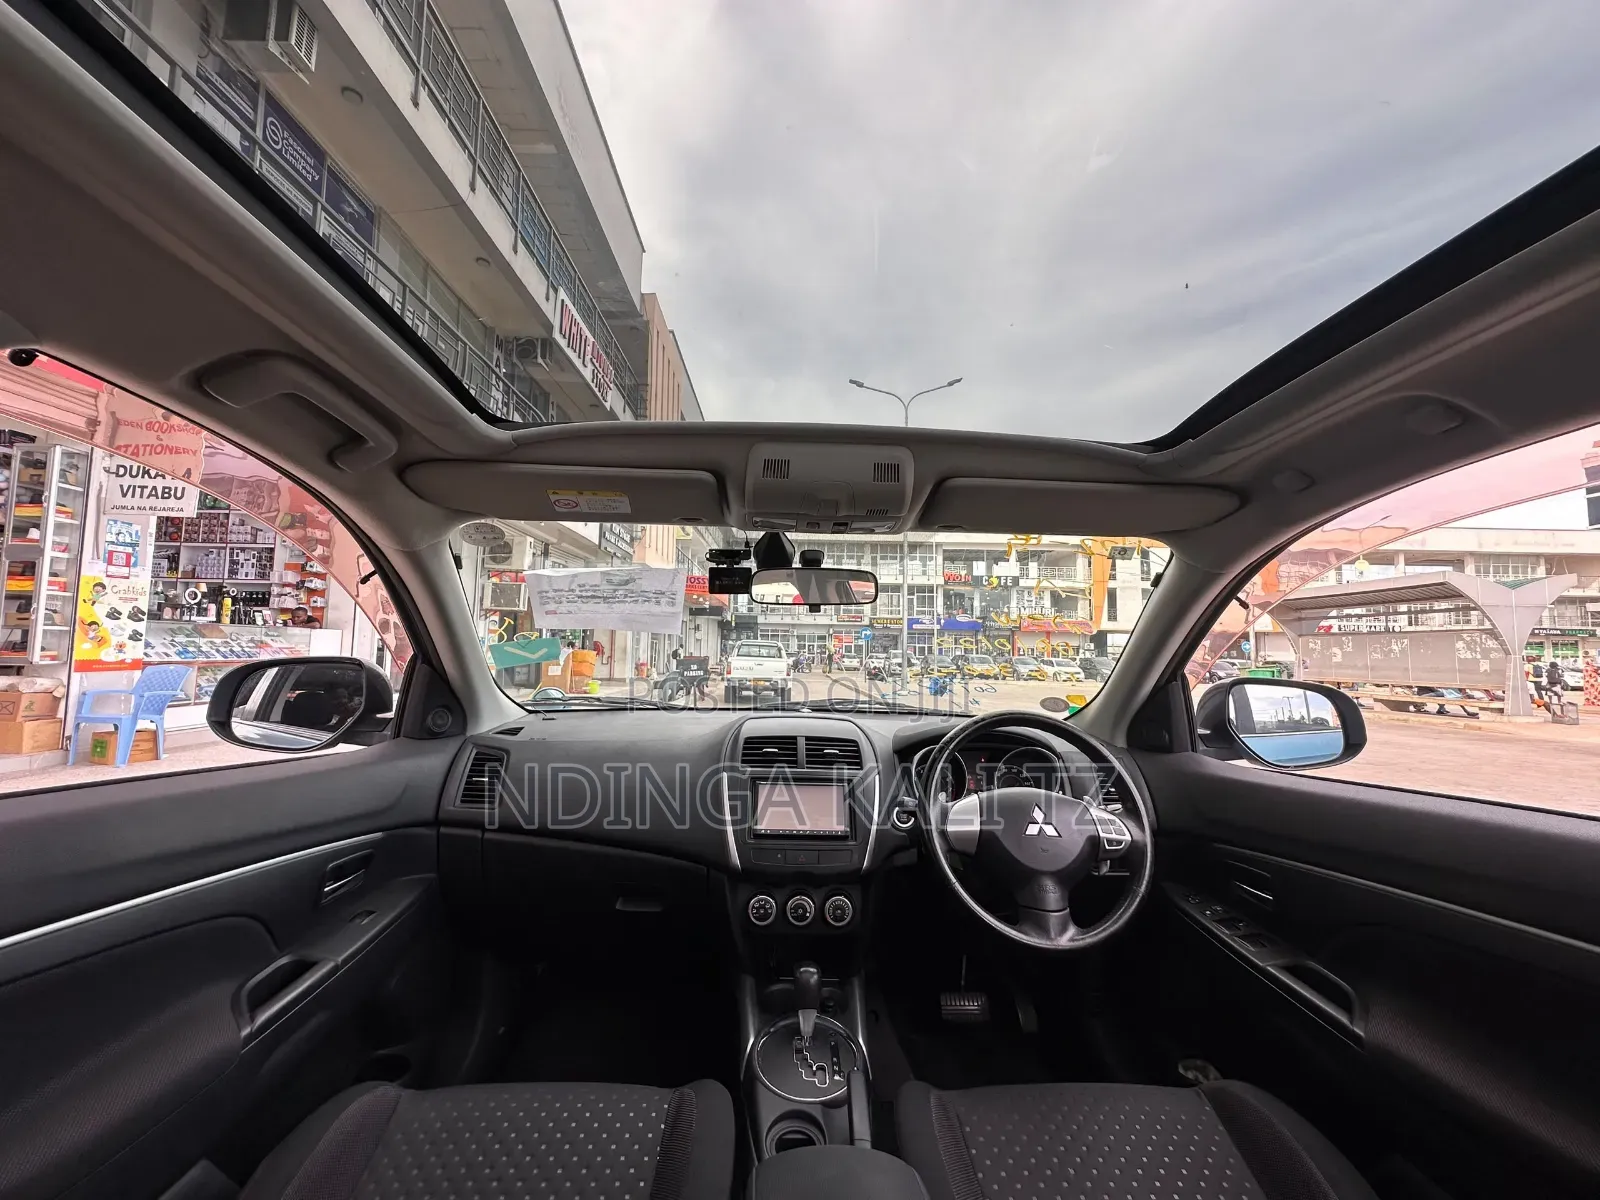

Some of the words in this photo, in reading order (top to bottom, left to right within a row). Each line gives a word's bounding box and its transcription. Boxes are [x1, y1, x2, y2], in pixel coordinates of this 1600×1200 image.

[282, 146, 312, 182] Limited
[283, 139, 319, 181] Company
[119, 484, 186, 501] VITABU
[148, 505, 185, 513] REJAREJA
[1340, 624, 1394, 632] SUPERMARKT
